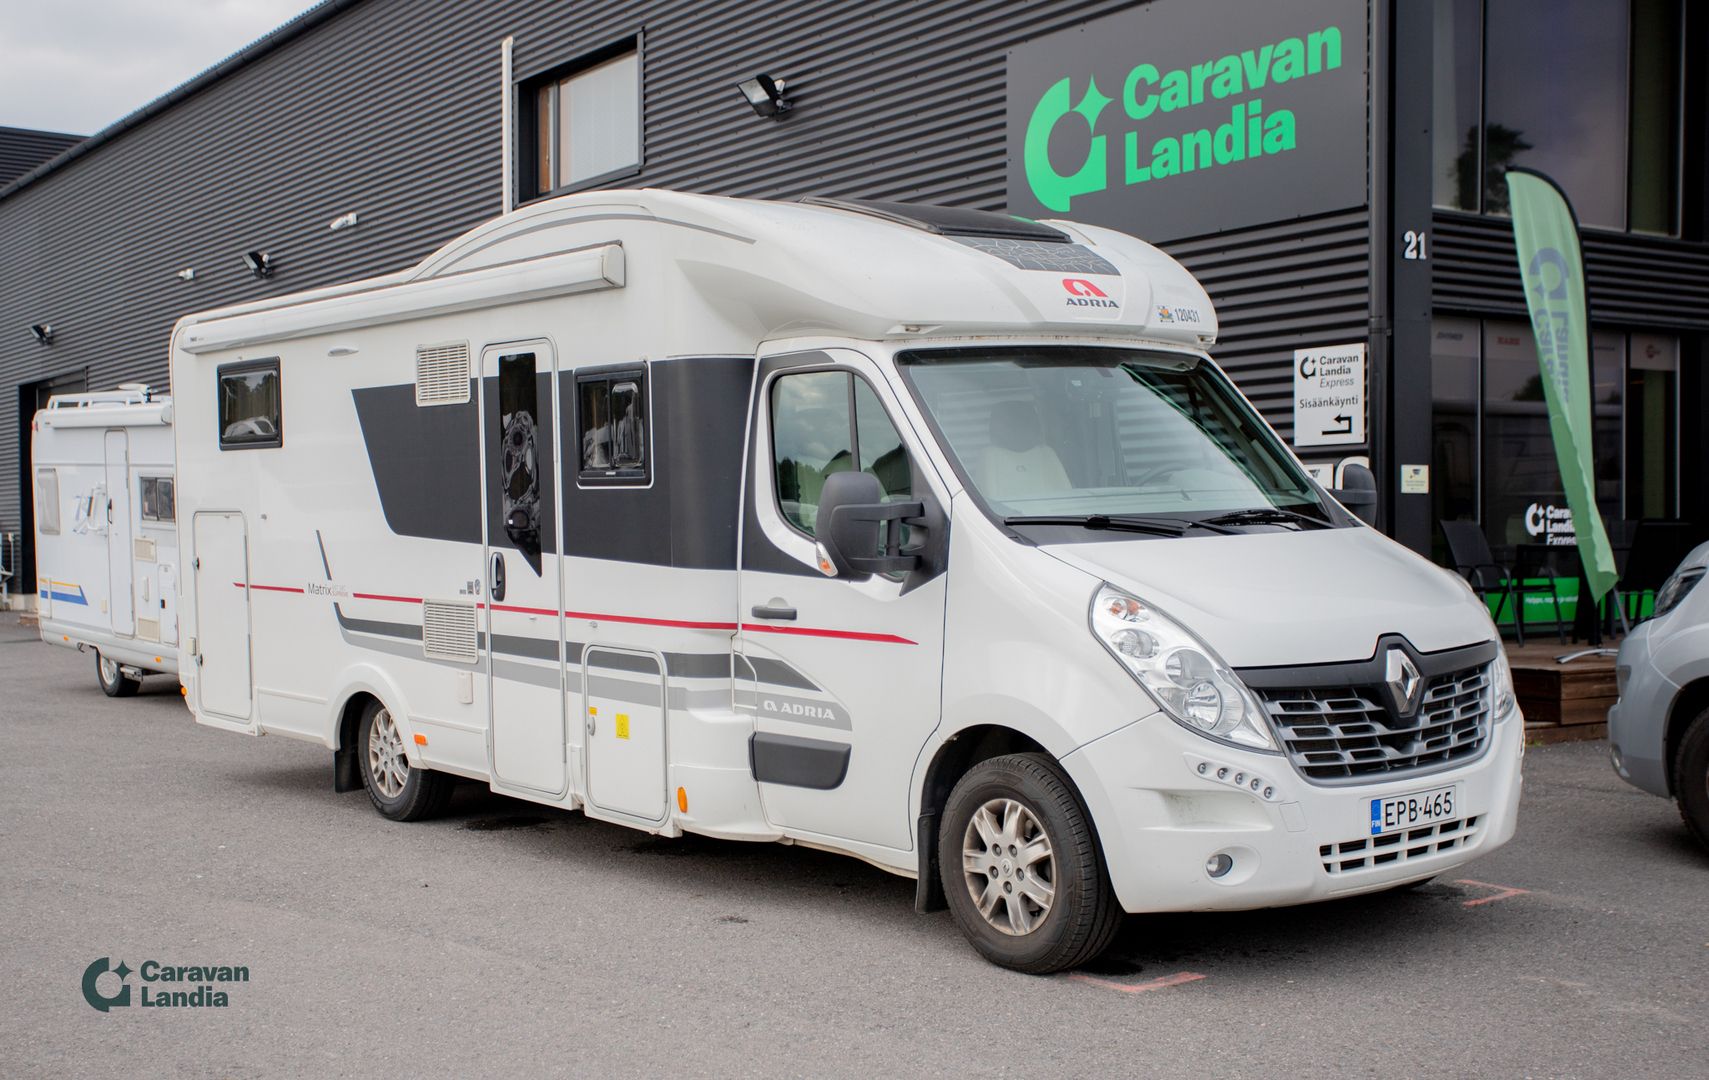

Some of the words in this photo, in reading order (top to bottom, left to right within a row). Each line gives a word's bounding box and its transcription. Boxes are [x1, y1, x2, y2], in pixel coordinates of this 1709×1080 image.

[1123, 26, 1342, 120] Caravan
[1125, 99, 1296, 185] Landia
[1404, 230, 1427, 260] 21
[1066, 297, 1120, 309] ADRIA
[1174, 308, 1201, 323] 120431
[1320, 355, 1359, 366] Caravan
[1320, 366, 1352, 377] Landia
[1320, 378, 1355, 389] Express
[1300, 394, 1359, 409] Sisäänkäynti
[1546, 505, 1572, 519] Cara
[1546, 519, 1576, 533] Landi
[1546, 533, 1577, 546] Expres
[308, 583, 334, 596] Matrix
[781, 702, 836, 720] ADRIA
